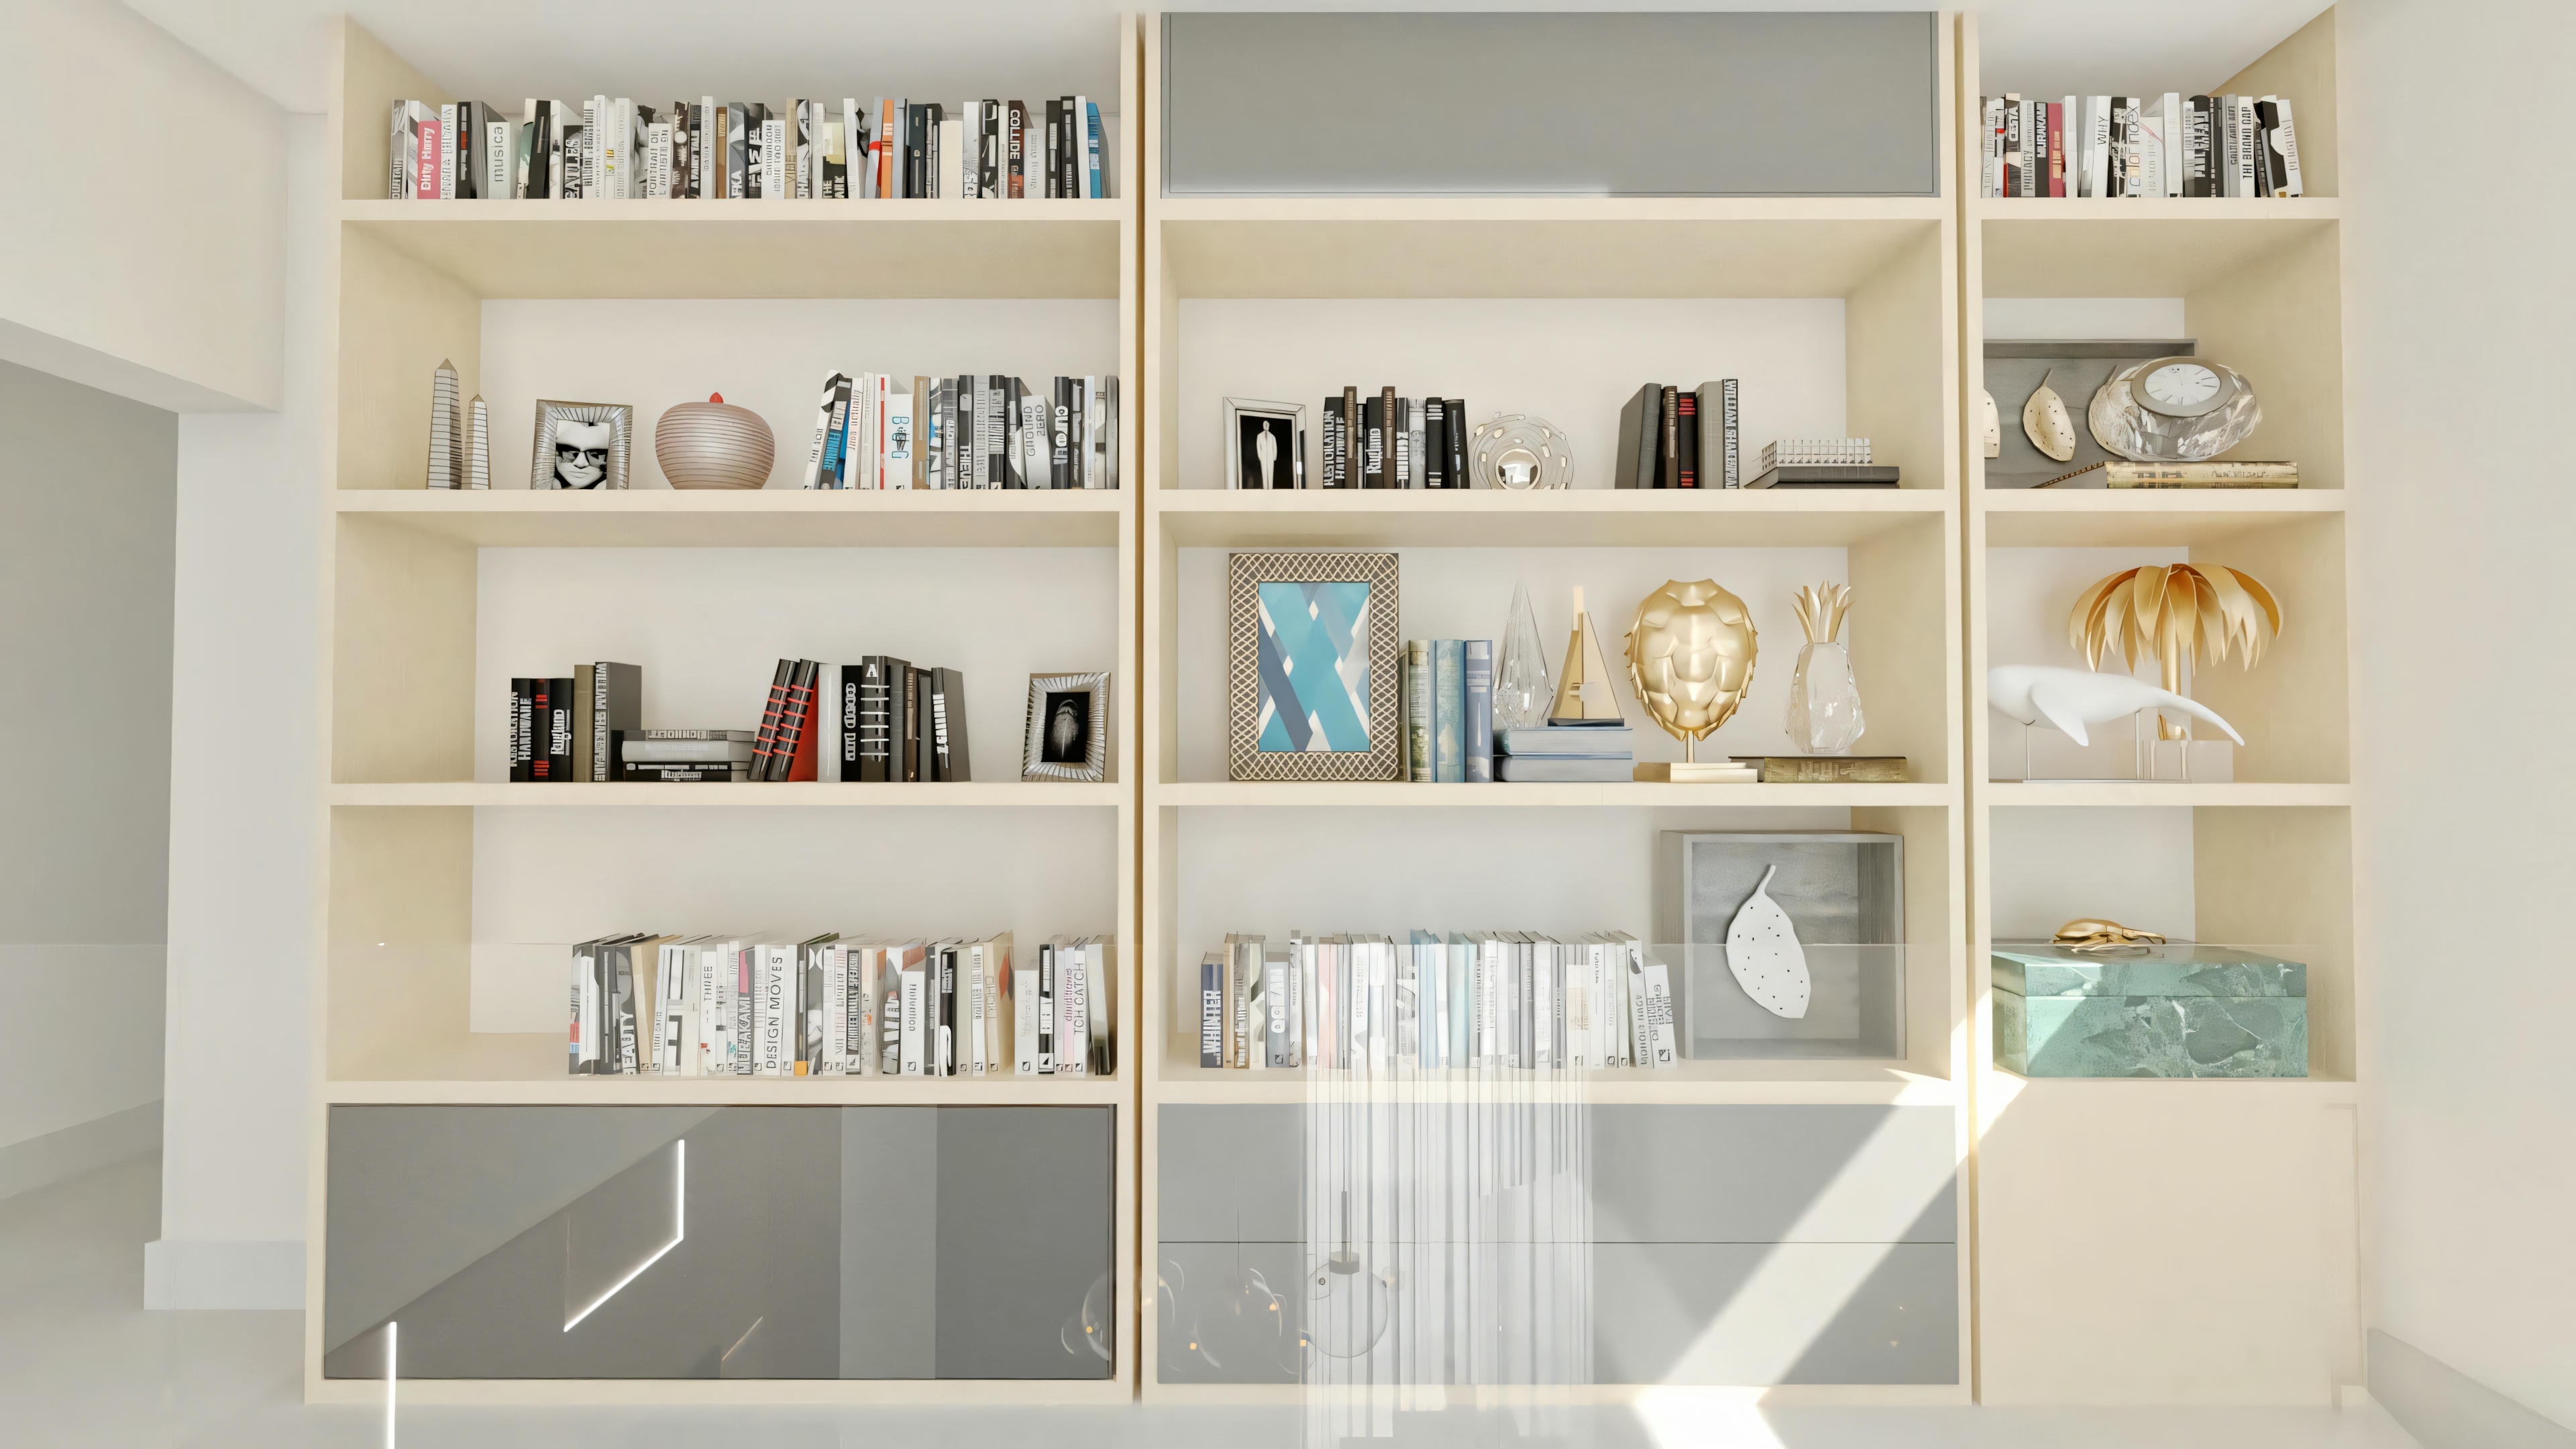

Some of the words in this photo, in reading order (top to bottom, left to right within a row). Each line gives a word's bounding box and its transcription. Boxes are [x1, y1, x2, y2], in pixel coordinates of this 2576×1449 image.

[494, 126, 504, 182] musica
[1010, 109, 1021, 160] COLLIDE
[2097, 115, 2109, 145] WHY
[769, 957, 782, 1010] MOVES
[1073, 963, 1085, 1006] CATCH
[766, 1017, 780, 1069] DESIGN
